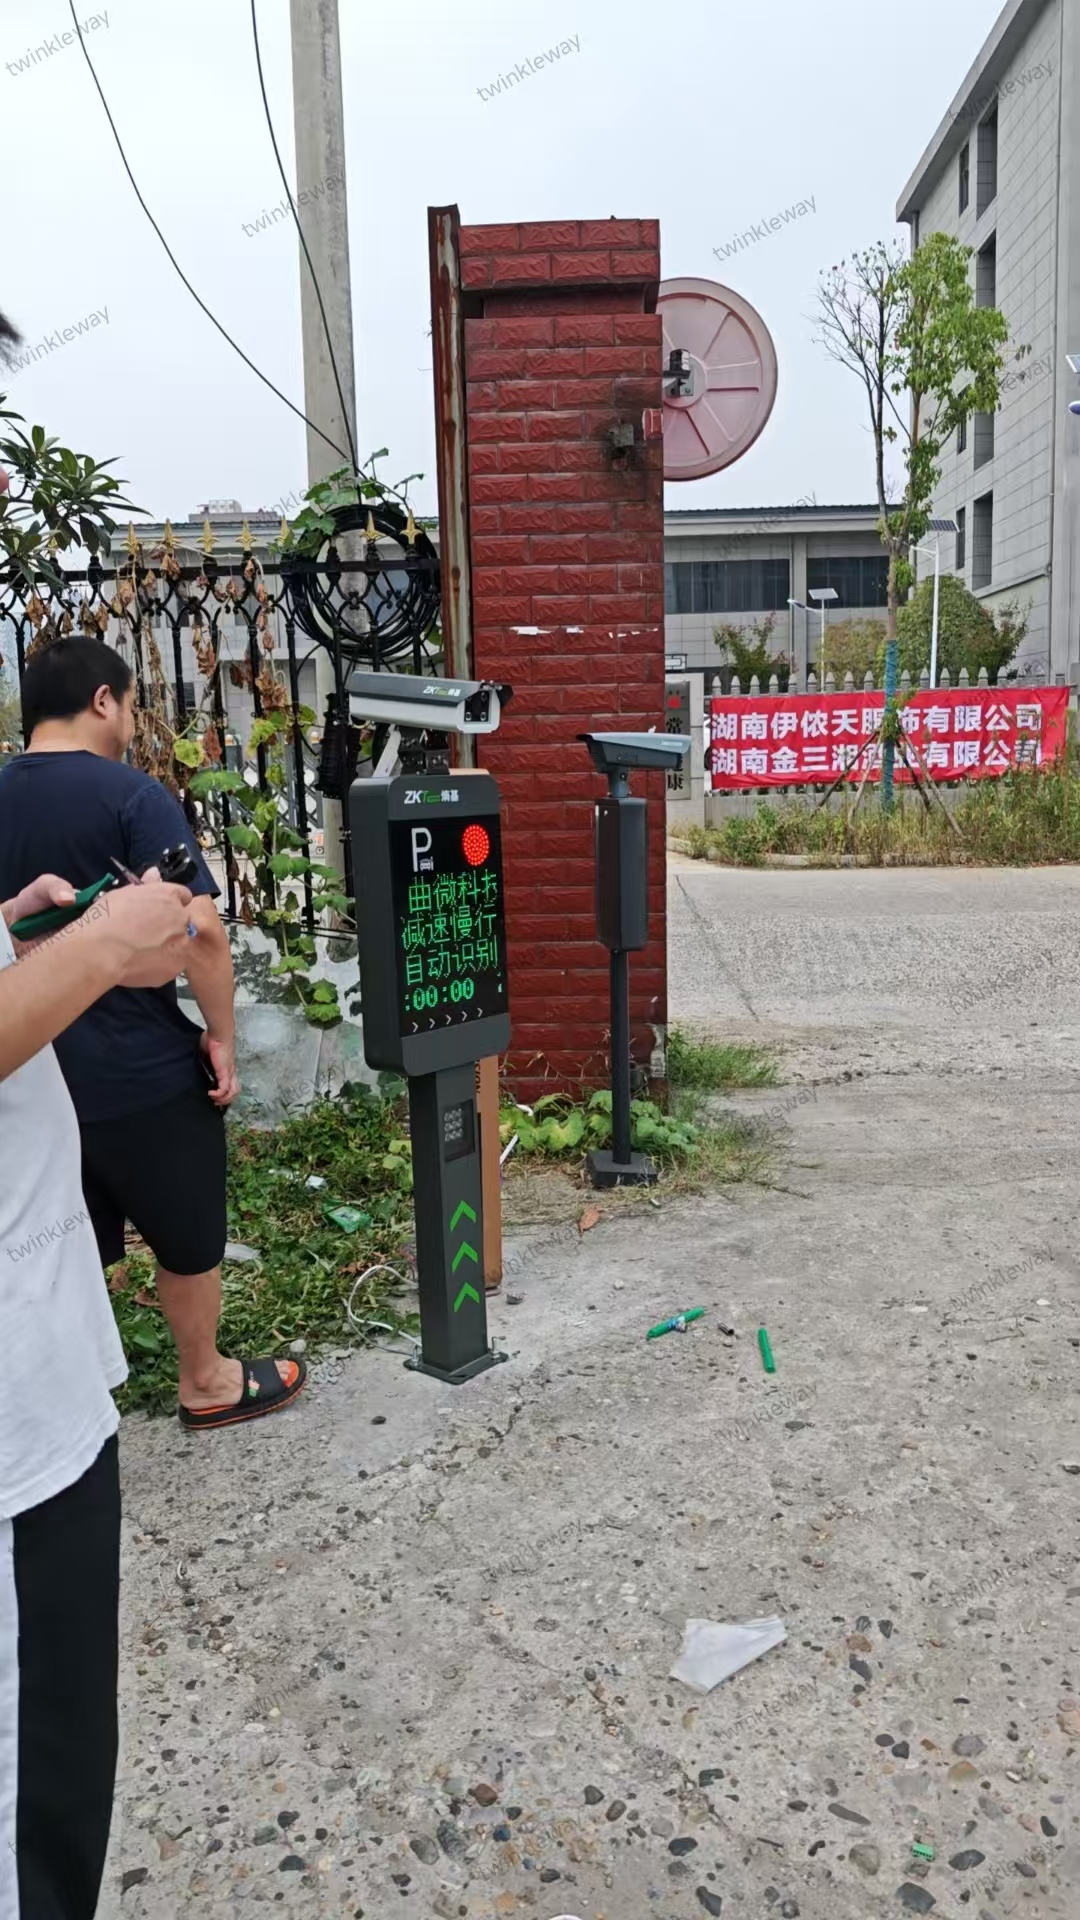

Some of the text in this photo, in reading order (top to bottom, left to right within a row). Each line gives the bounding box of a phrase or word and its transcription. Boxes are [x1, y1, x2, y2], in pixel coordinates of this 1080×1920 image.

[411, 827, 432, 873] P
[401, 903, 497, 955] 减速慢行
